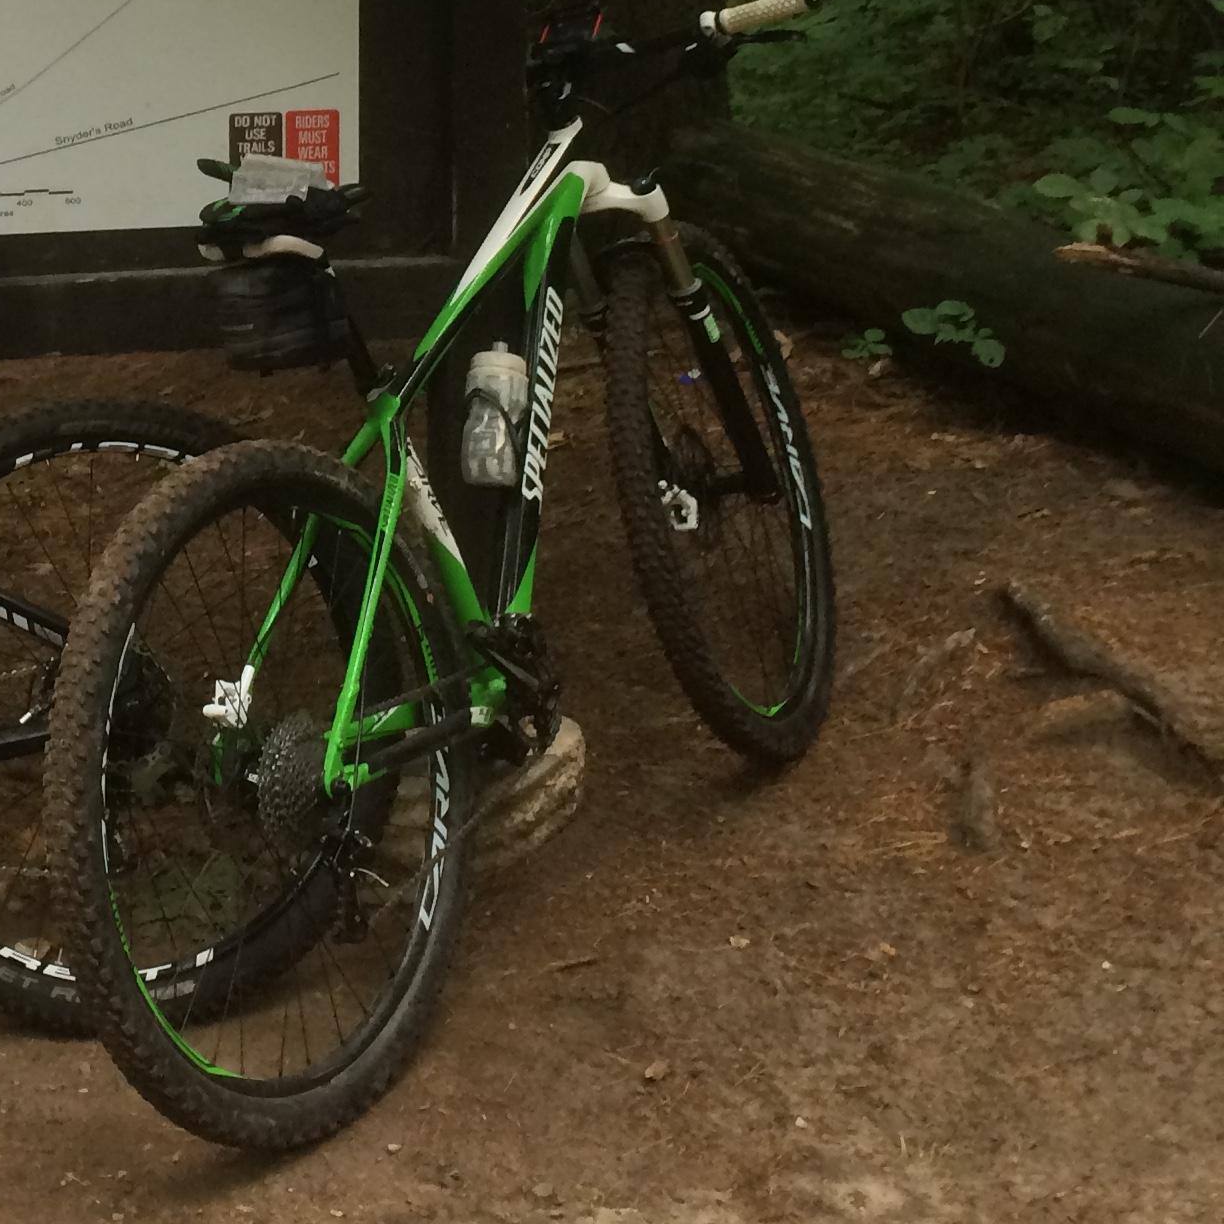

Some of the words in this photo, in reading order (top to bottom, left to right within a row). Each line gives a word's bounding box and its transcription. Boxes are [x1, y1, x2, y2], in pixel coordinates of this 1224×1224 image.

[234, 115, 250, 127] DO
[254, 114, 277, 127] NOT
[295, 114, 330, 129] RIDERS
[54, 128, 102, 146] Snyder's
[104, 117, 134, 132] Road
[245, 128, 267, 140] USE
[298, 130, 328, 145] MUST
[237, 140, 276, 154] TRAILS
[297, 145, 328, 160] WEAR
[16, 199, 33, 207] 400
[521, 286, 564, 515] SPECIALIZED
